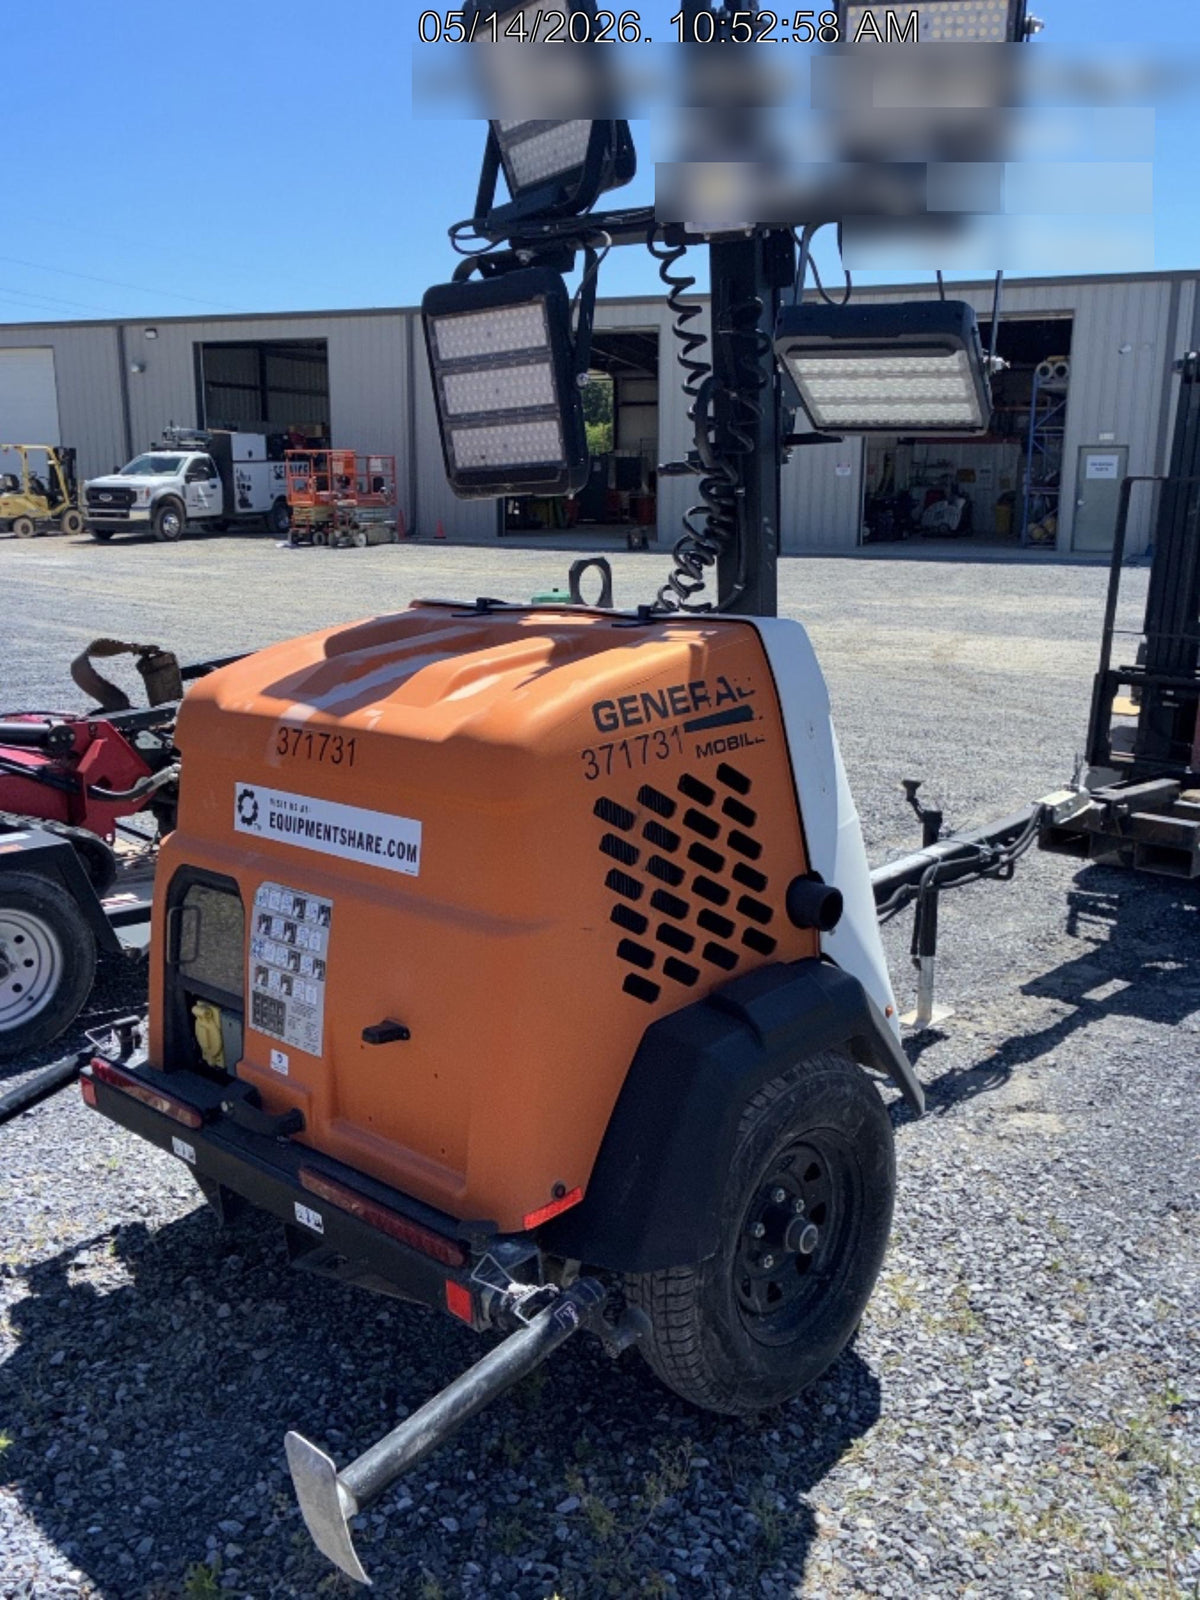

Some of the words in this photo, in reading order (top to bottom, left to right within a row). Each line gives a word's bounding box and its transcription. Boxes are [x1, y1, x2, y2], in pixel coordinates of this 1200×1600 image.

[276, 726, 356, 767] 371731
[581, 725, 684, 780] 371731
[269, 811, 418, 863] EQUIPMENTSHARE.COM
